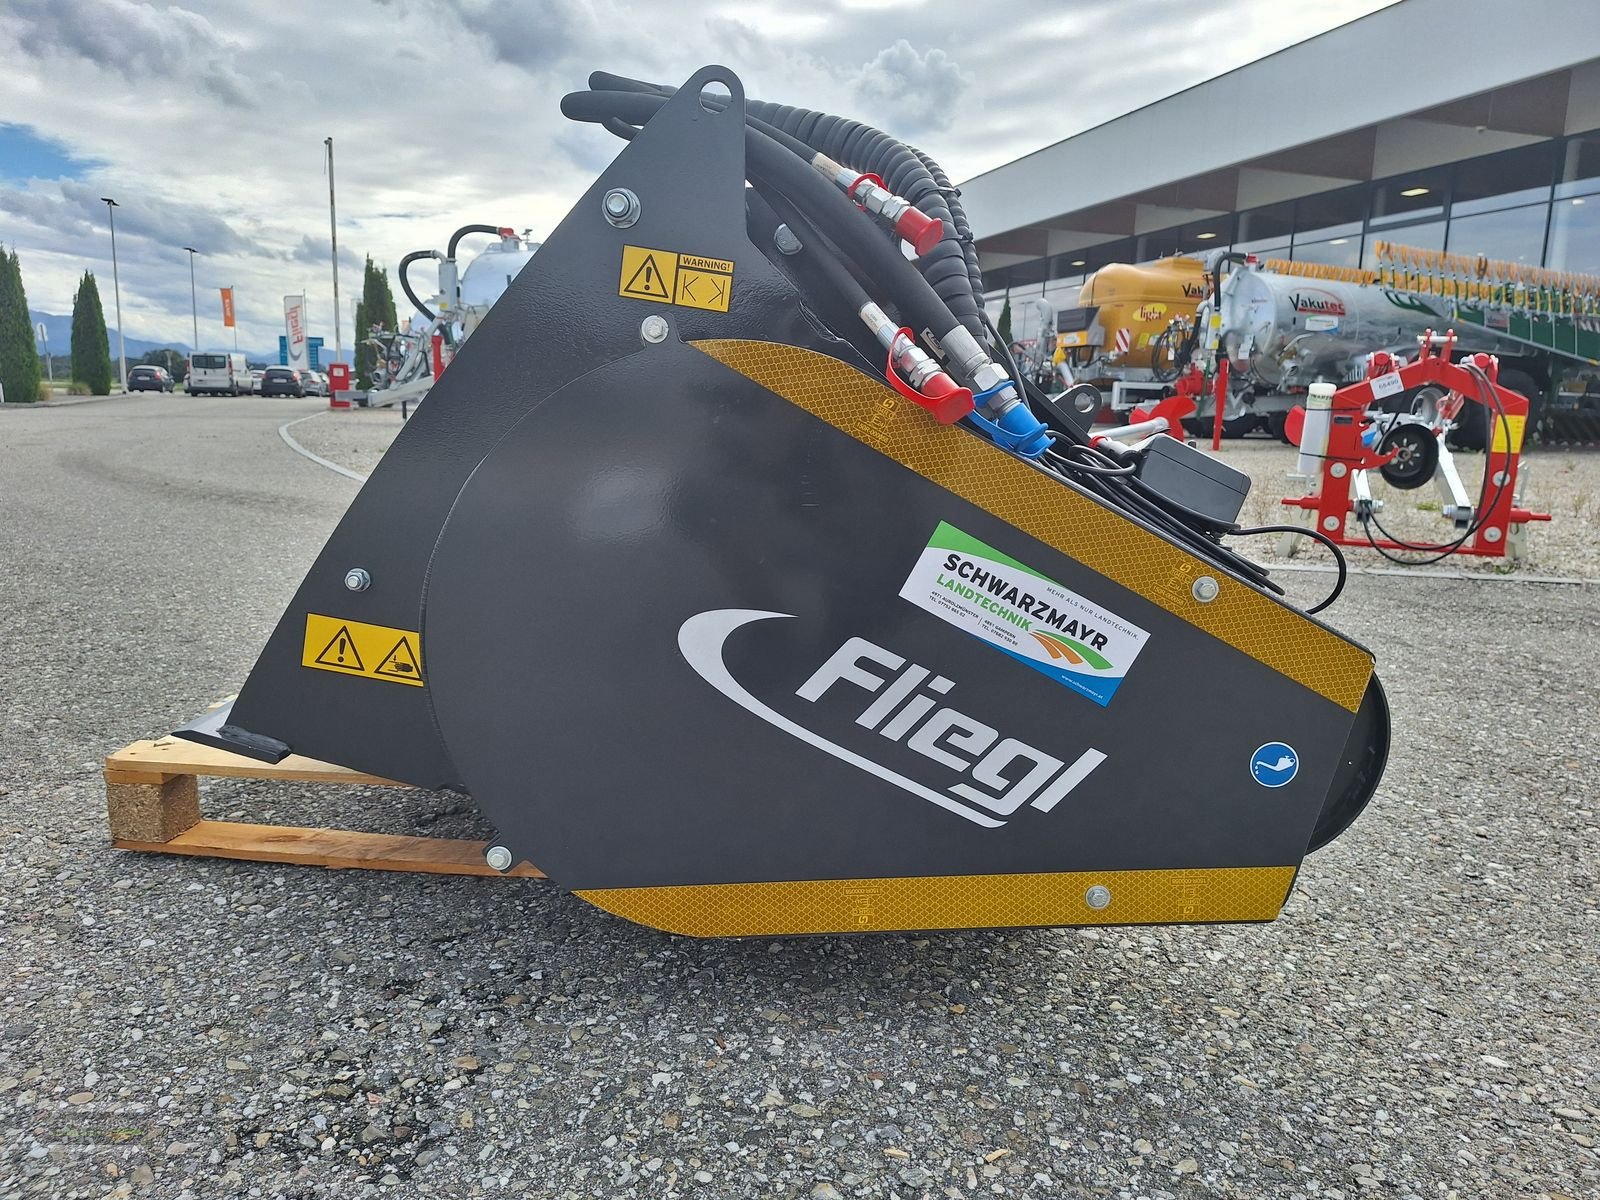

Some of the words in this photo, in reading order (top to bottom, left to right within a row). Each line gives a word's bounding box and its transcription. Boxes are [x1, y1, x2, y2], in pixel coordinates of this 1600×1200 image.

[683, 257, 730, 272] WARNING!
[1288, 293, 1345, 312] Vakutec
[936, 573, 1033, 632] LANDTECHNIK
[943, 553, 1109, 652] SCHWARZMAYR
[1046, 586, 1065, 600] MEHR
[1065, 598, 1078, 608] ALS
[1080, 605, 1094, 616] NUR
[1094, 612, 1139, 641] LANDTECHNIK.
[795, 636, 1109, 817] Fliegl
